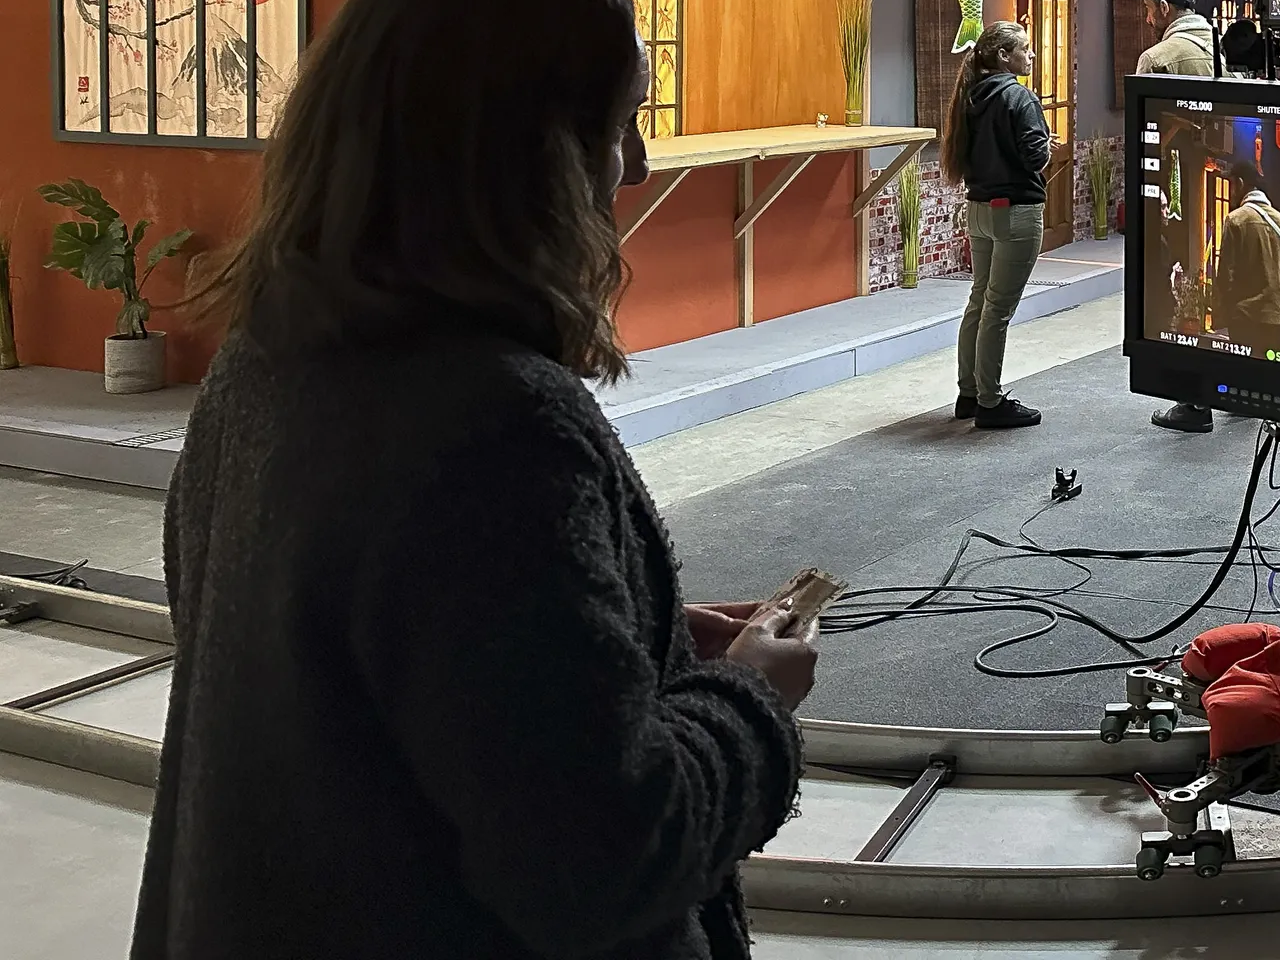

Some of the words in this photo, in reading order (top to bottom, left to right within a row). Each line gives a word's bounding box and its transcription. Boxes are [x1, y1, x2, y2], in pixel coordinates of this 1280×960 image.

[1177, 100, 1188, 108] FPS
[1188, 100, 1213, 112] 25.000
[1160, 331, 1172, 341] BAT
[1212, 340, 1225, 350] BAT
